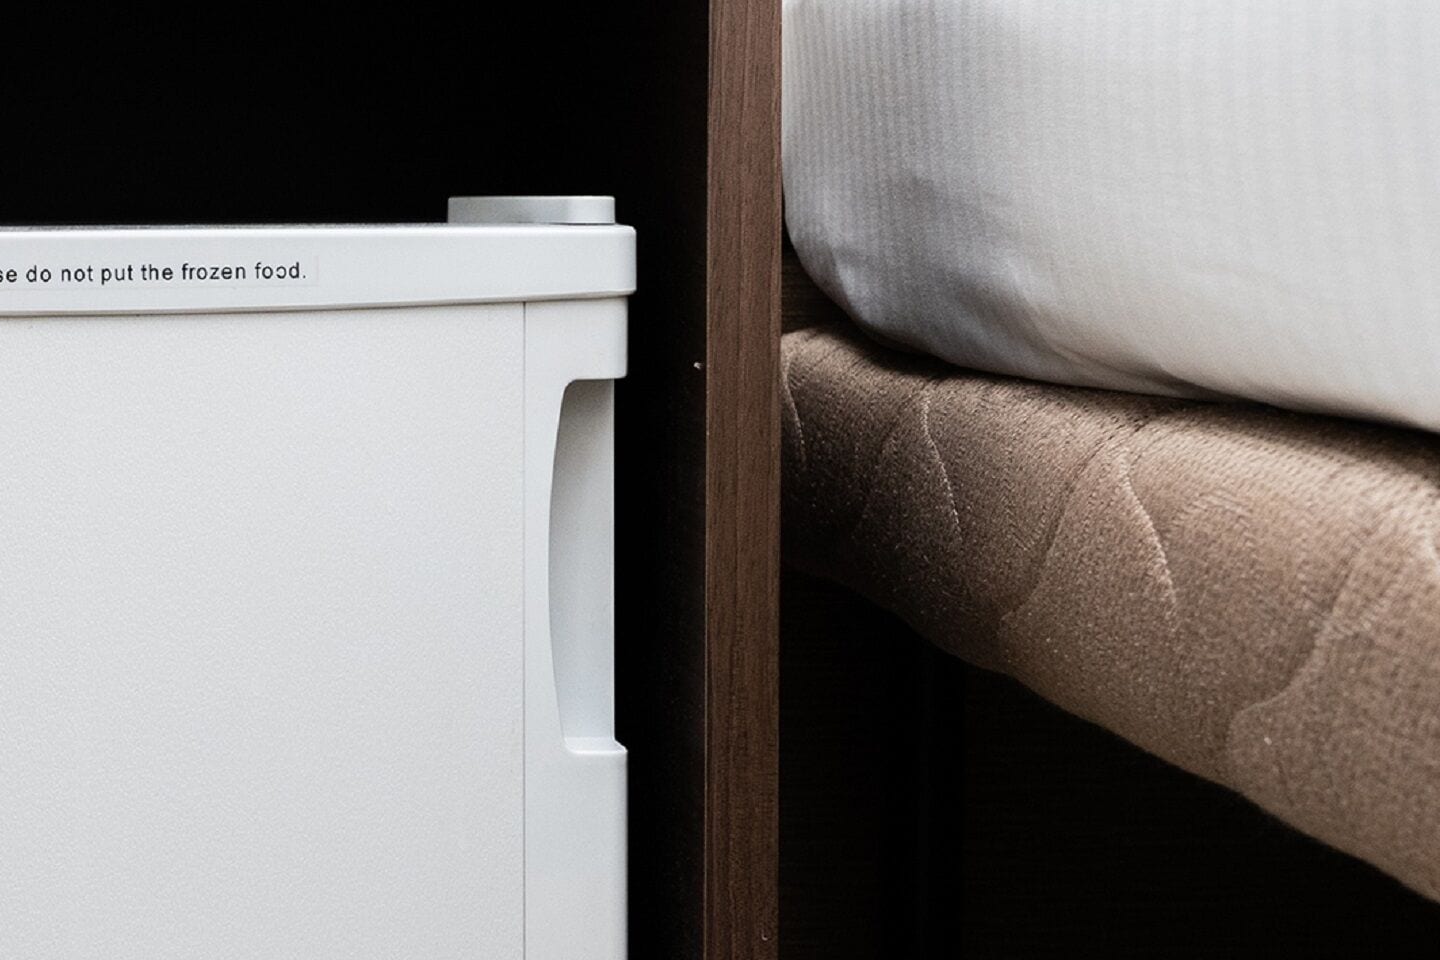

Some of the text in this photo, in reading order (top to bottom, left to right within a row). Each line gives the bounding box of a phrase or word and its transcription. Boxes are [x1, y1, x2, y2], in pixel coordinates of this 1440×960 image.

[25, 264, 52, 283] do
[61, 264, 94, 283] not
[101, 264, 134, 286] put
[140, 263, 174, 281] the
[181, 262, 246, 281] frozen
[254, 261, 307, 280] food.
